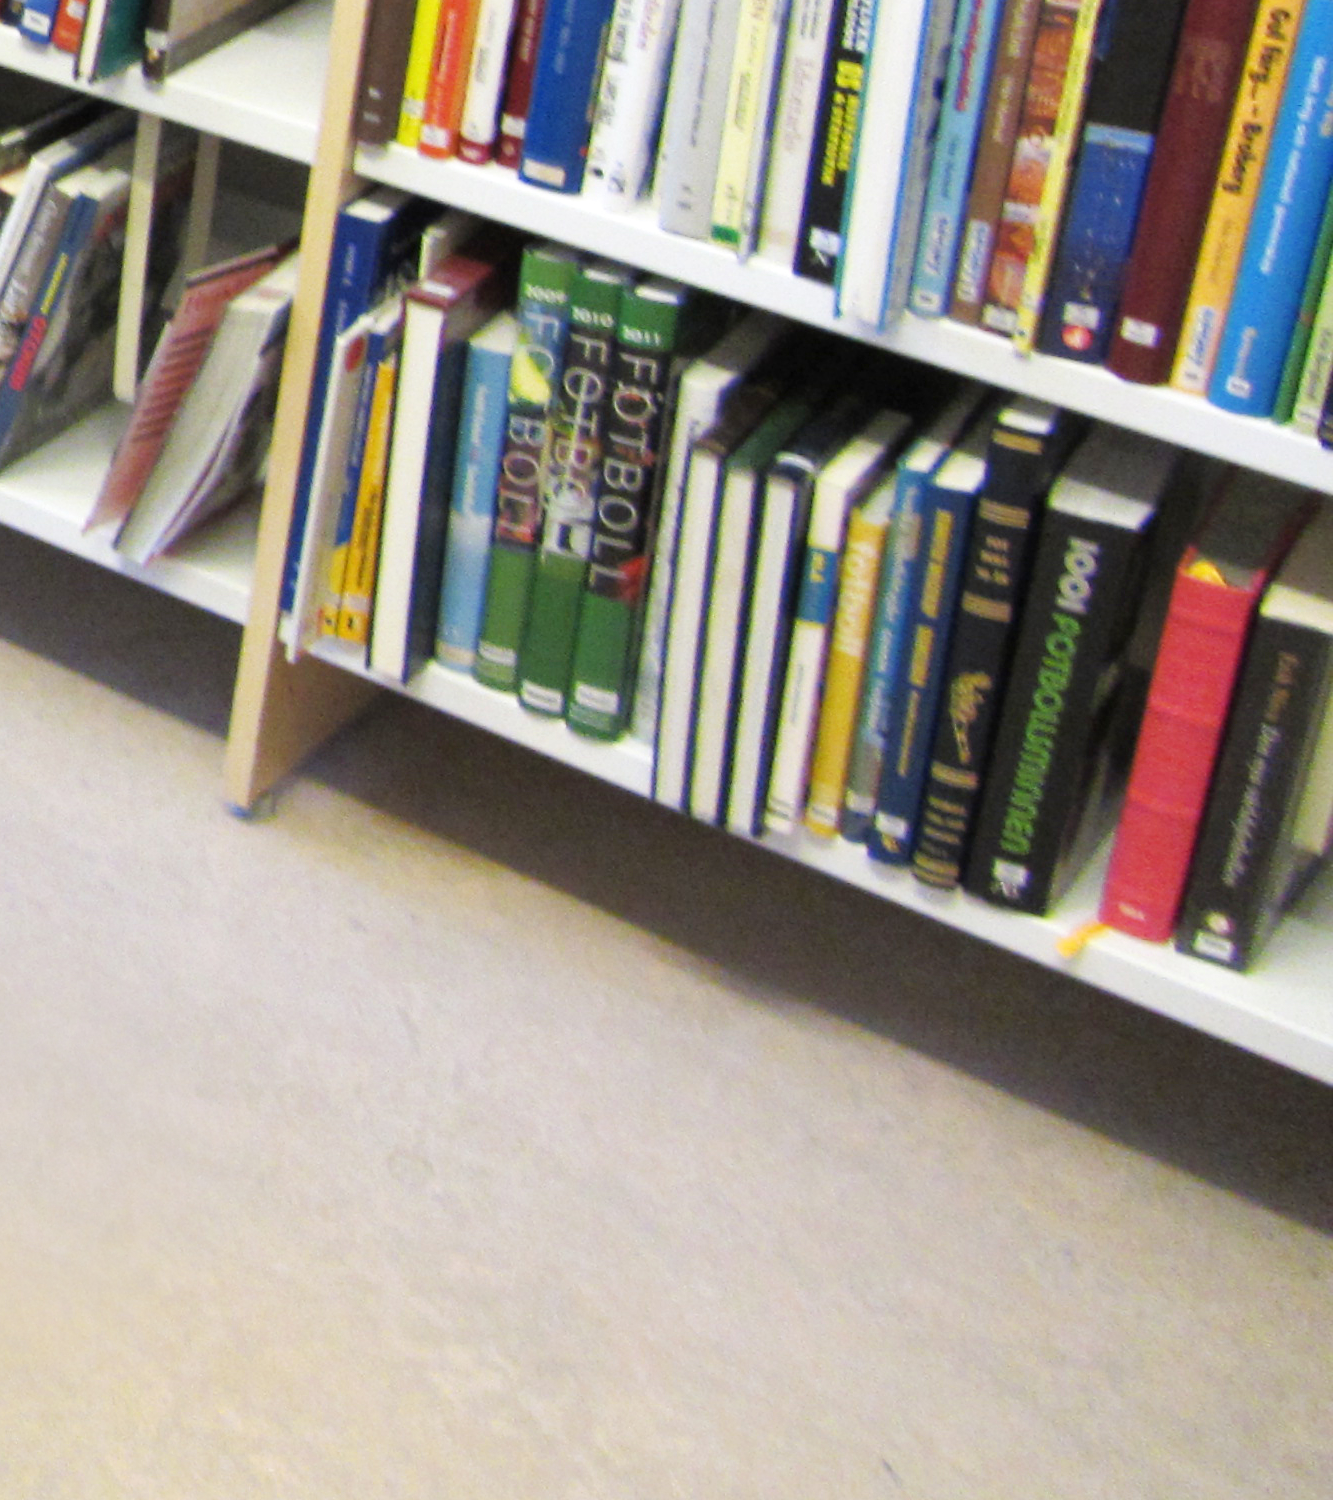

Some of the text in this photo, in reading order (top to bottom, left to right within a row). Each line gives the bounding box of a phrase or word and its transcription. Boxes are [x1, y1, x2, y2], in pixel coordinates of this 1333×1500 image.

[571, 305, 615, 328] 2010
[621, 323, 662, 348] 2011
[496, 310, 561, 541] FOBOLL
[589, 351, 659, 588] FOTBOLL
[1054, 535, 1100, 616] 1001
